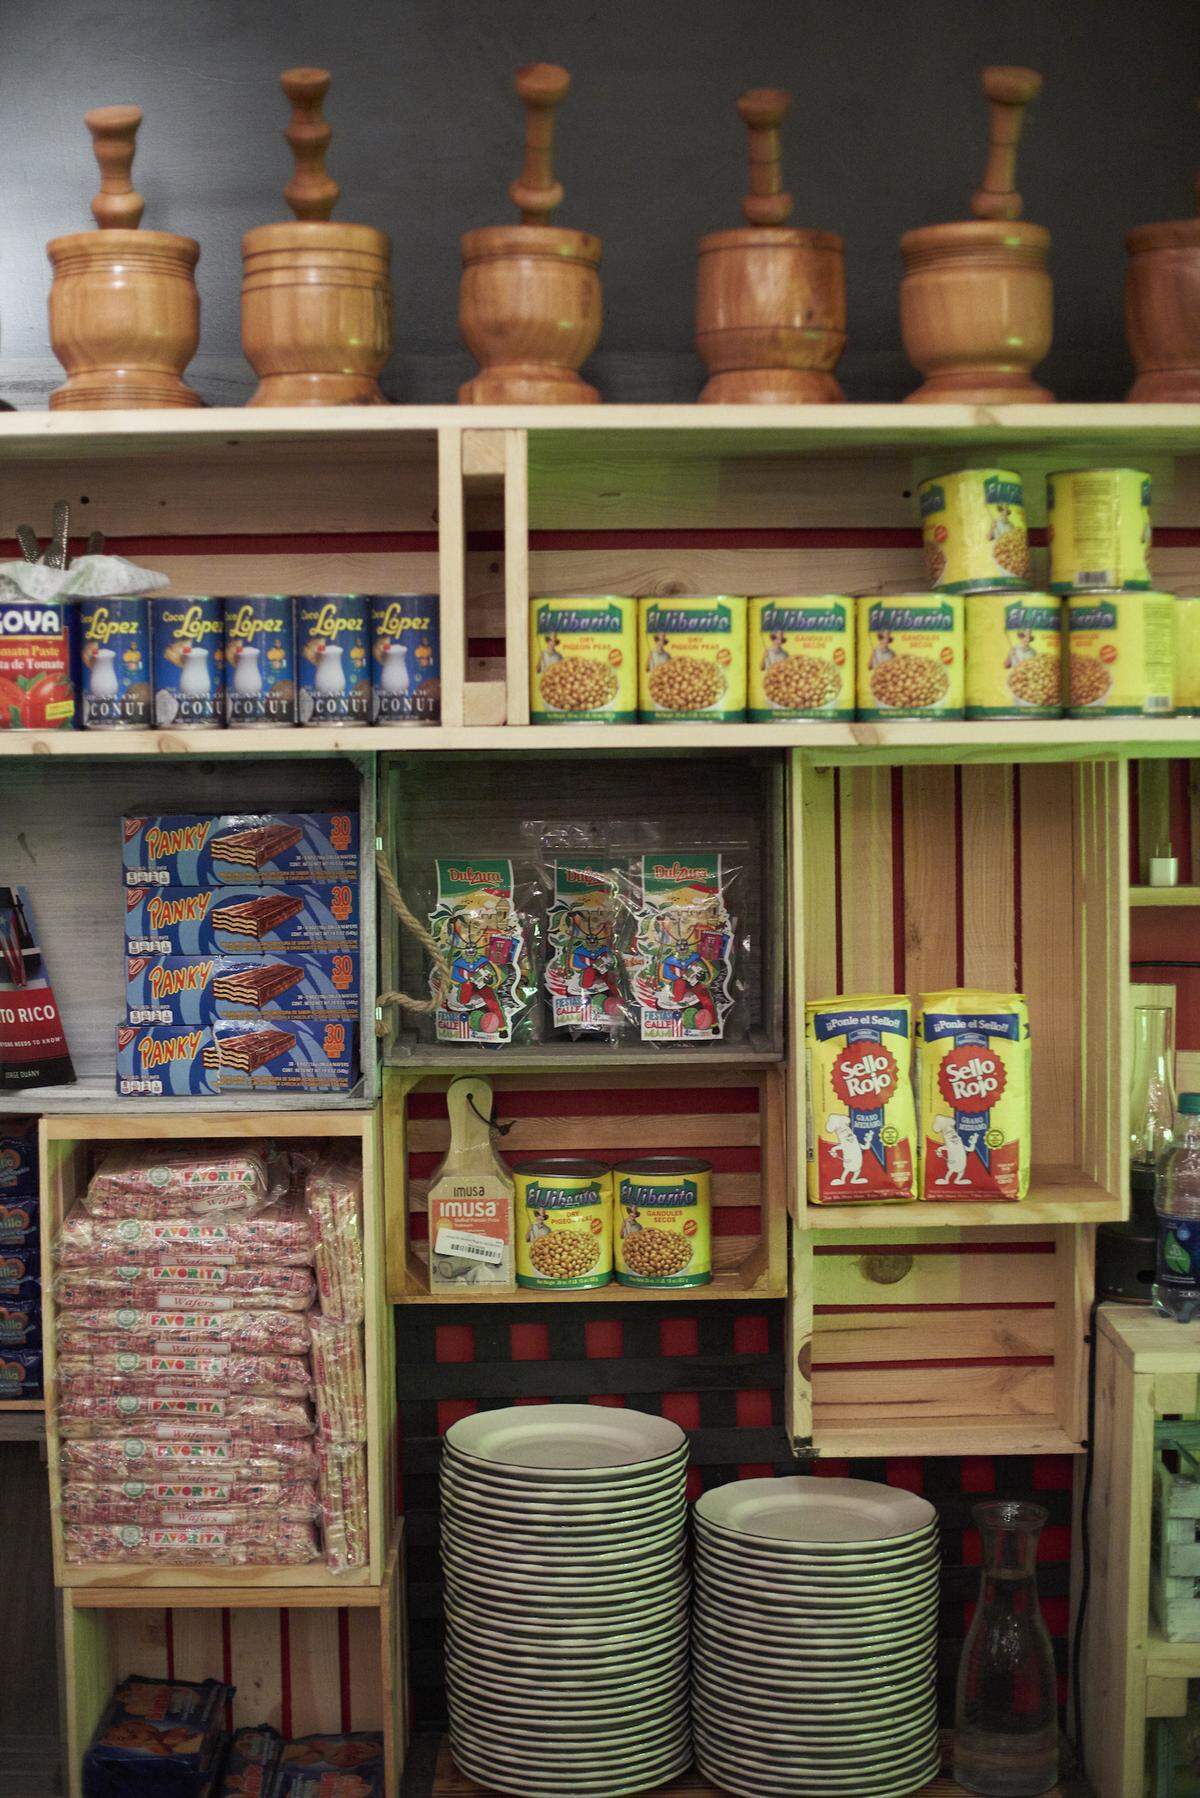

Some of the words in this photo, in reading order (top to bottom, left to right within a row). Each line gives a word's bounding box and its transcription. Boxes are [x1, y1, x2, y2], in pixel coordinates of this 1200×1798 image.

[0, 610, 60, 633] OYA
[27, 658, 65, 670] Tomate
[331, 815, 351, 836] 30
[145, 821, 211, 861] PANKY
[331, 885, 352, 907] 30
[147, 892, 212, 929] PANKY
[332, 955, 352, 975] 30
[149, 960, 214, 999] PANKY
[18, 1004, 56, 1023] RICO
[860, 1015, 870, 1024] el
[324, 1023, 345, 1044] 30
[967, 1019, 978, 1029] el
[138, 1031, 203, 1070] PANKY
[840, 1054, 889, 1080] Sello
[945, 1058, 996, 1083] Sello
[845, 1072, 892, 1097] Rojo
[951, 1075, 999, 1100] Rojo
[184, 1170, 252, 1182] FAVORITA
[527, 1188, 541, 1204] El
[622, 1185, 632, 1202] El
[636, 1187, 694, 1205] Jibarito
[155, 1227, 225, 1238] FAVORITA
[153, 1267, 222, 1278] FAVORITA
[174, 1297, 215, 1308] Wafers
[151, 1315, 219, 1327] FAVORITA
[153, 1401, 220, 1413] FAVORITA
[157, 1446, 225, 1456] FAVORITA
[158, 1486, 226, 1497] FAVORITA
